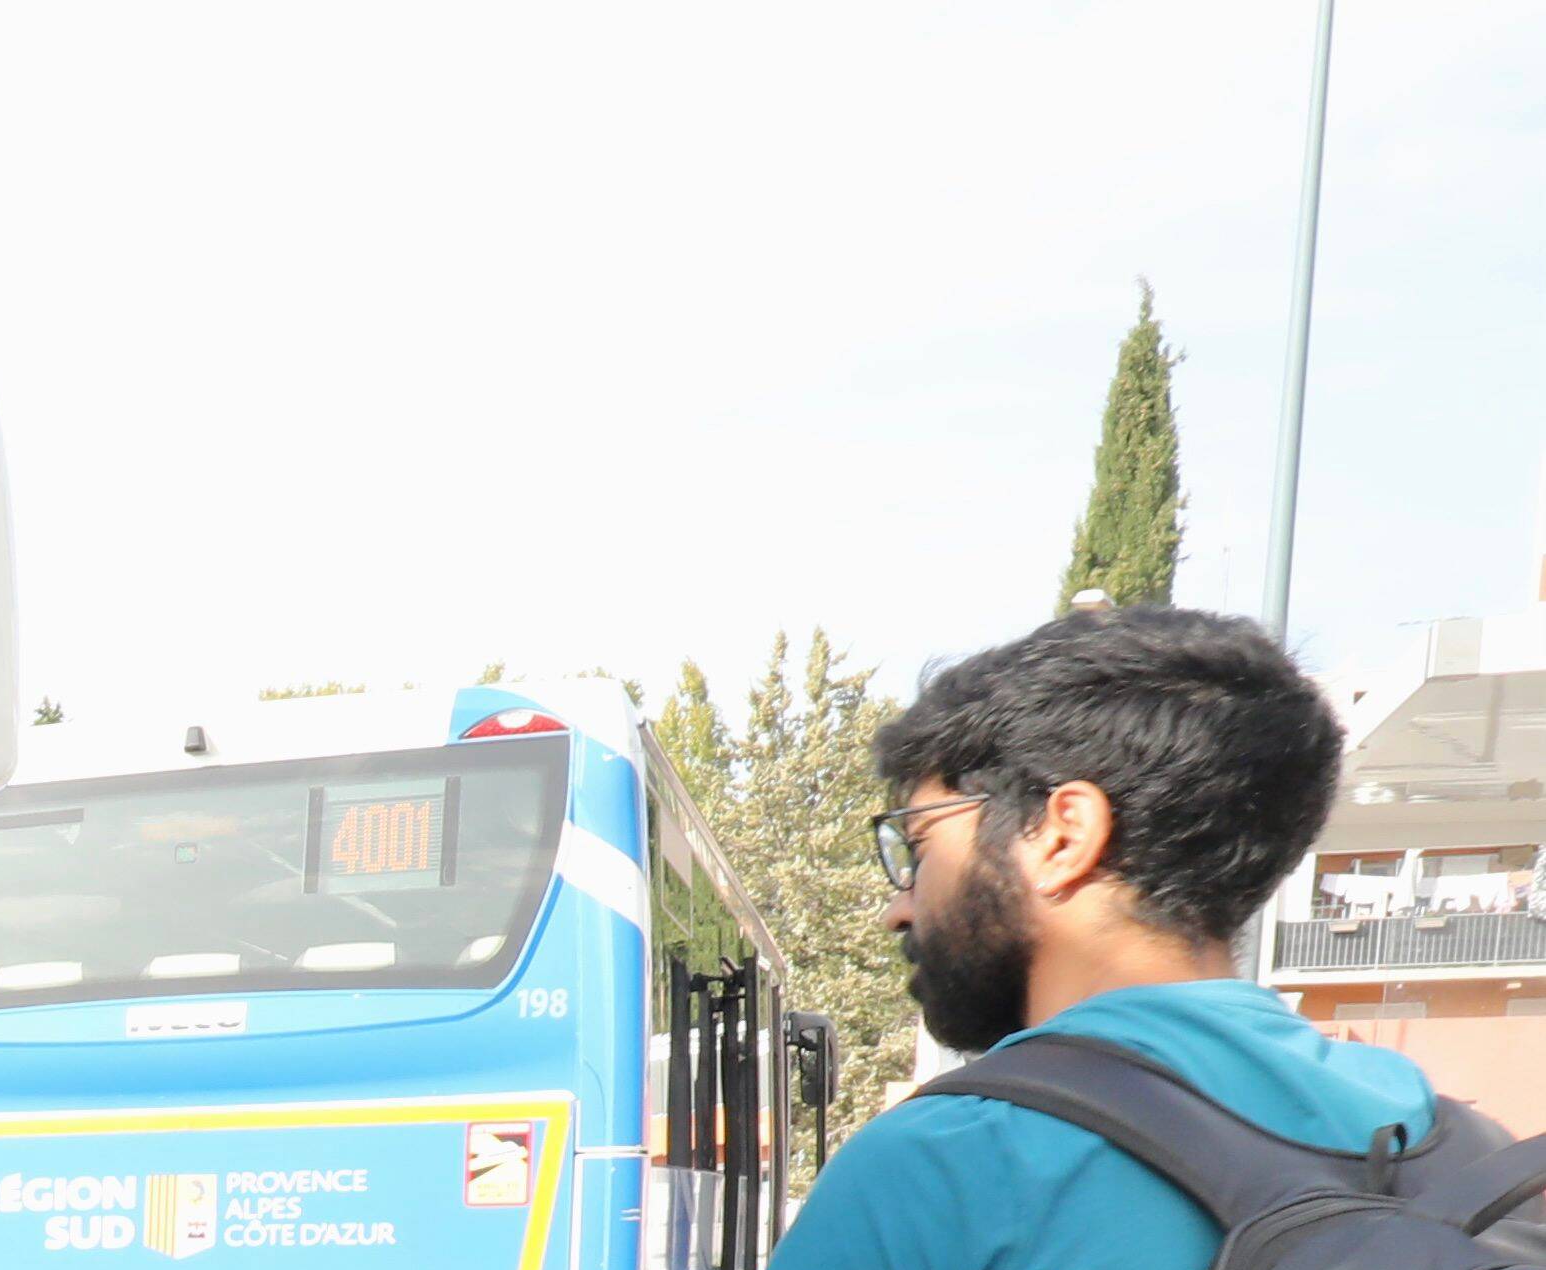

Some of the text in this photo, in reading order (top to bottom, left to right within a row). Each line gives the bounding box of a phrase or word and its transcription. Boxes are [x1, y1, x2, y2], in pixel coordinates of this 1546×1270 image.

[330, 800, 431, 874] 4001
[516, 988, 568, 1019] 198
[225, 1168, 369, 1194] PROVENCE
[224, 1196, 302, 1220] ALPES
[44, 1215, 136, 1251] SUD
[223, 1219, 397, 1248] CÔTE D'AZUR
